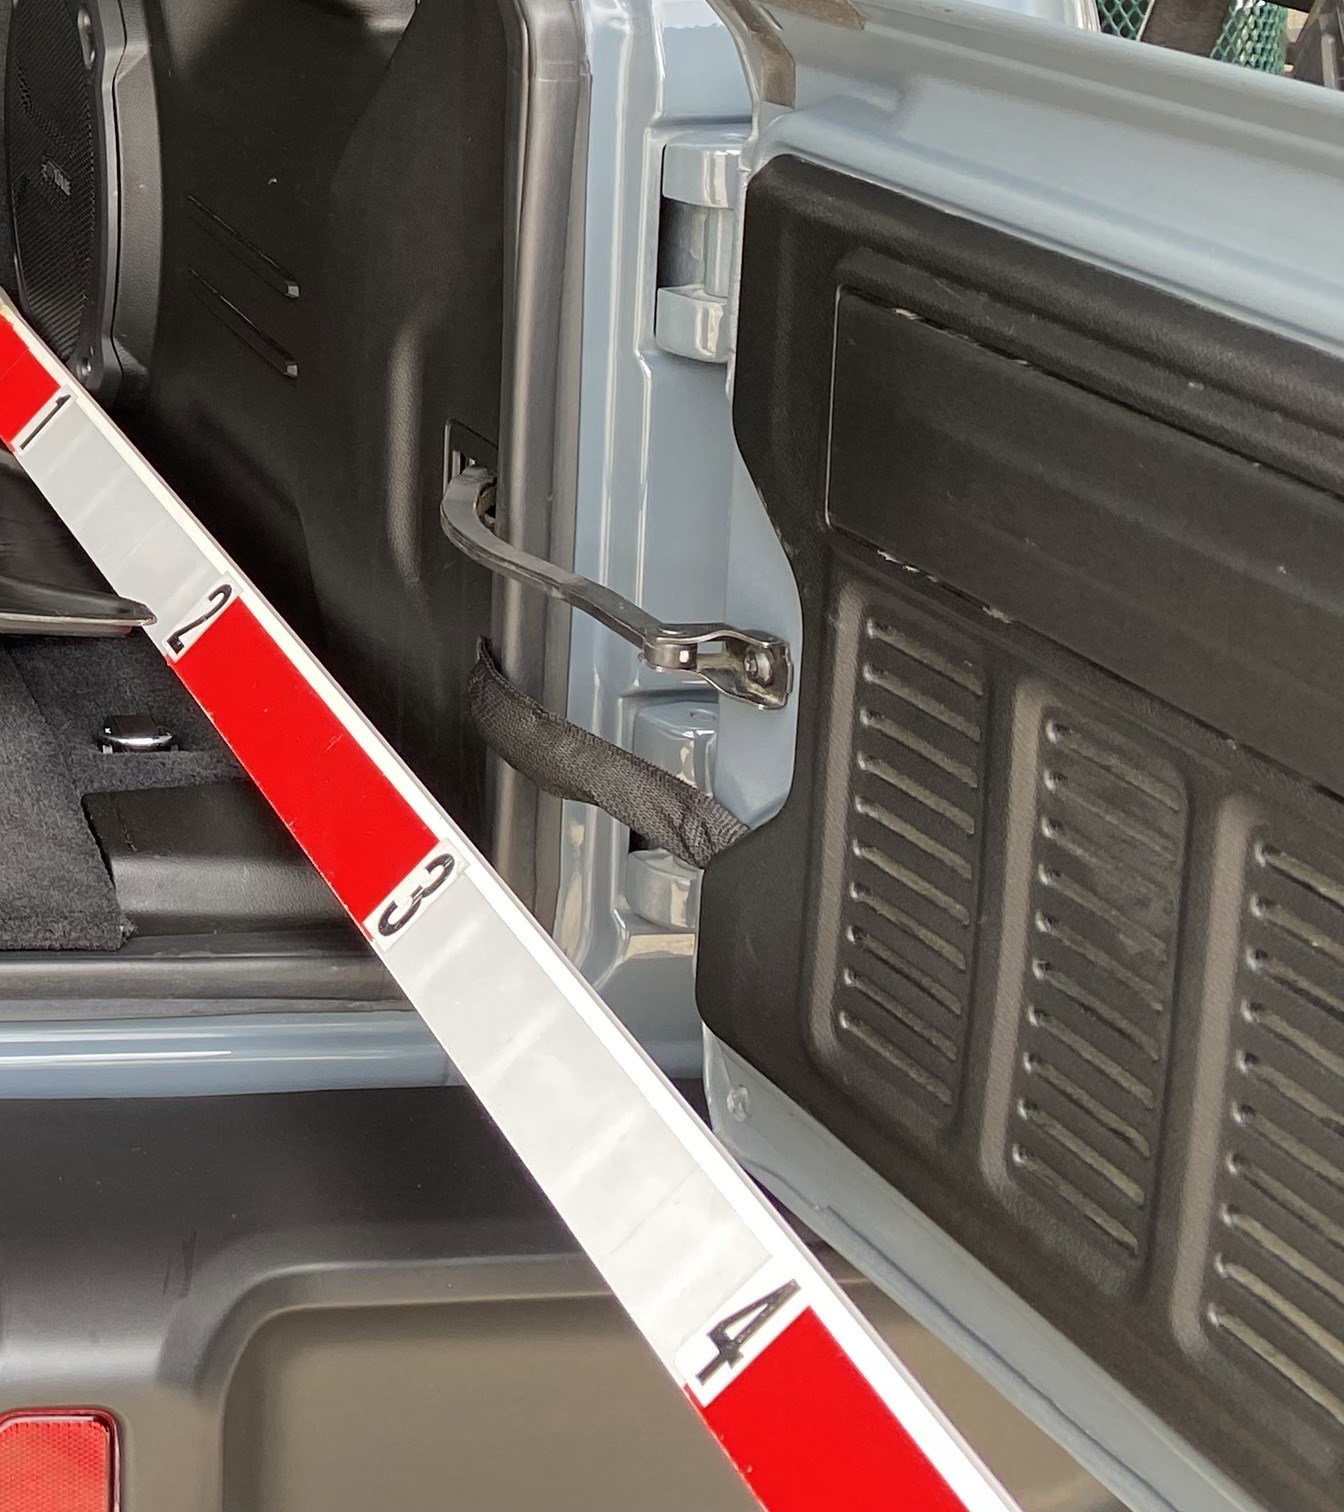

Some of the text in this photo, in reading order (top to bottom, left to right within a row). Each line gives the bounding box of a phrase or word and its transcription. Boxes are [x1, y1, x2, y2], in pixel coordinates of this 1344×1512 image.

[19, 394, 72, 450] 1
[167, 584, 232, 655] 2
[378, 853, 455, 937] 3
[695, 1278, 802, 1386] 4
